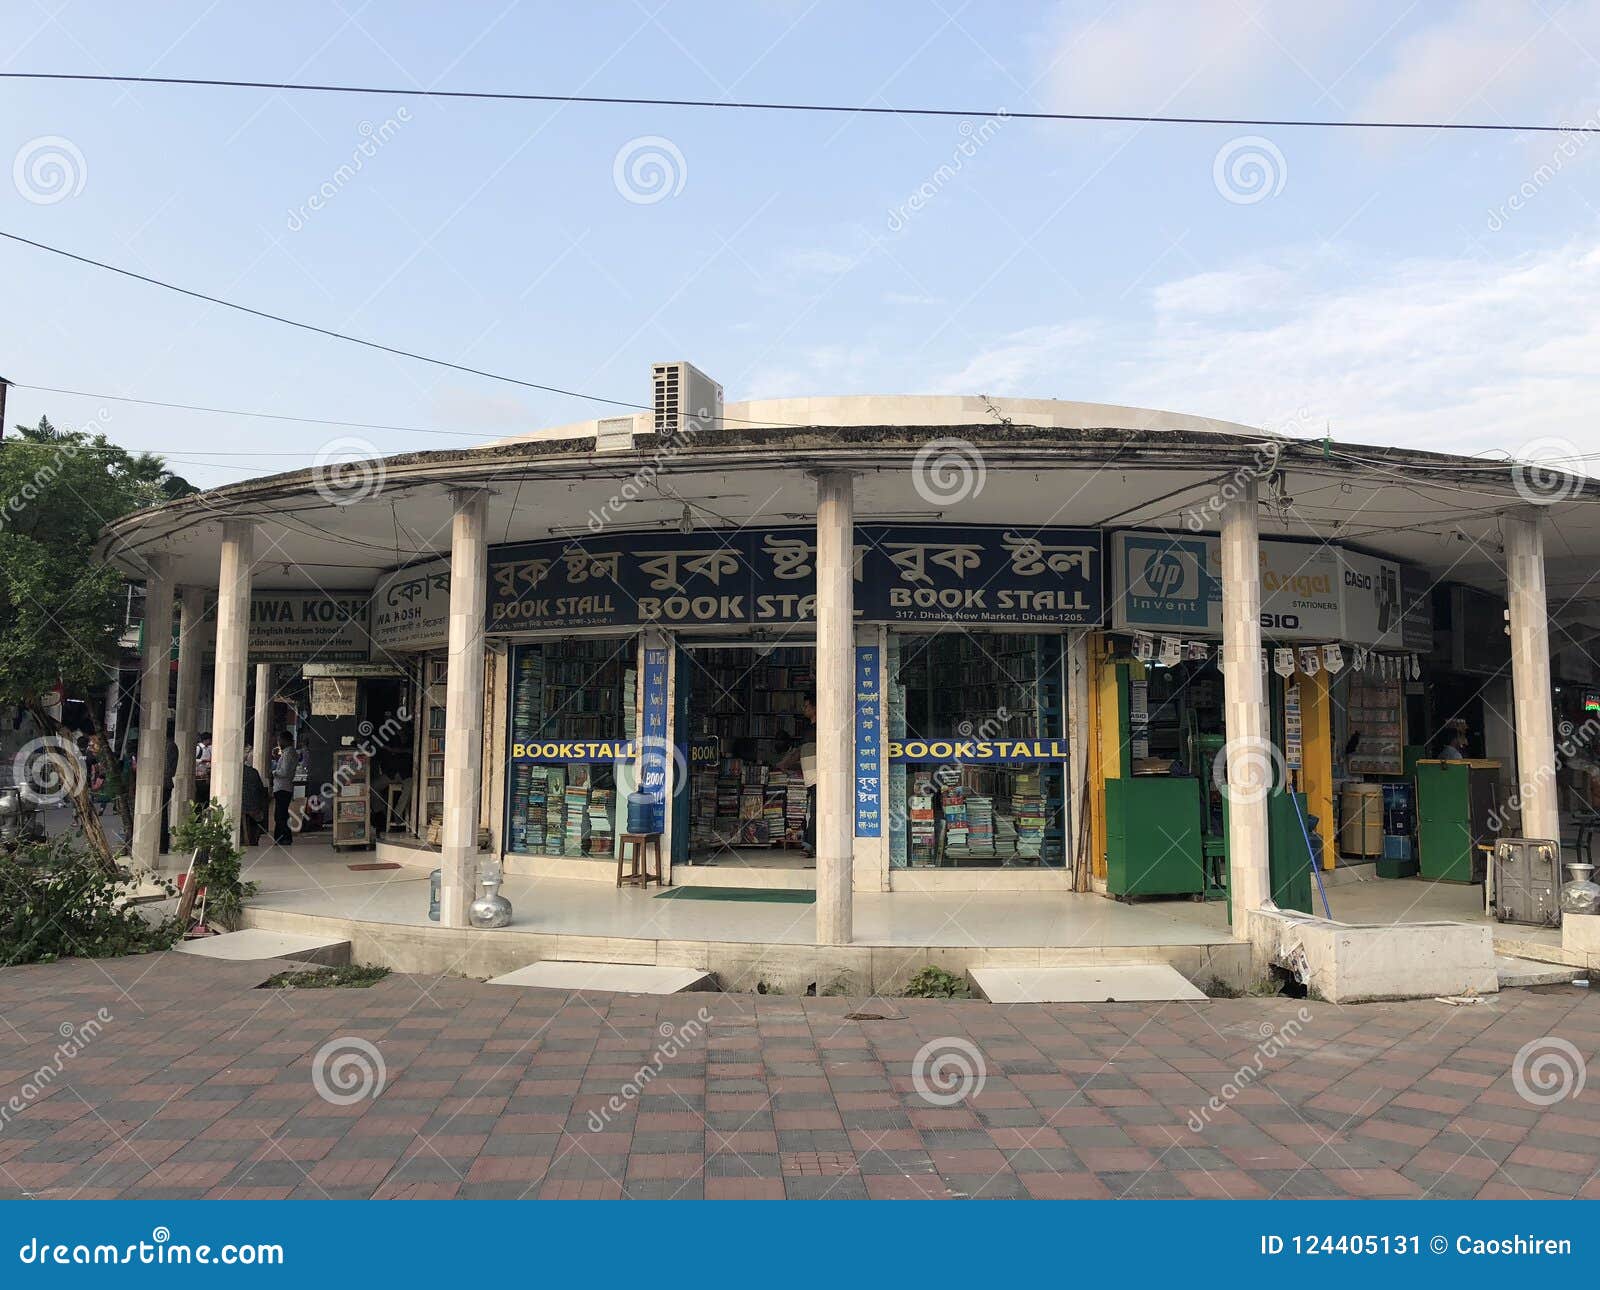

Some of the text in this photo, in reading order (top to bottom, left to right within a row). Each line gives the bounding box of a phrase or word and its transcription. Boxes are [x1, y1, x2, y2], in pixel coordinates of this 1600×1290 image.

[630, 549, 744, 594] বুক
[881, 541, 986, 586] বুক
[489, 558, 552, 598] বুক
[1344, 571, 1371, 589] CASIO
[492, 595, 616, 620] BOOK STALL
[637, 594, 865, 620] BOOK STA
[890, 588, 1090, 611] BOOK STALL
[1292, 600, 1338, 611] STATIONERS
[302, 600, 367, 622] KOSH
[394, 606, 422, 622] KOSH
[919, 611, 952, 620] Dhaka
[955, 612, 979, 620] New
[1221, 612, 1300, 630] SIO
[257, 625, 283, 637] English
[512, 743, 637, 759] BOOKSTALL
[692, 746, 715, 761] BOOK
[887, 741, 1068, 758] BOOKSTALL
[646, 772, 665, 786] BOOK
[652, 791, 664, 805] ALL
